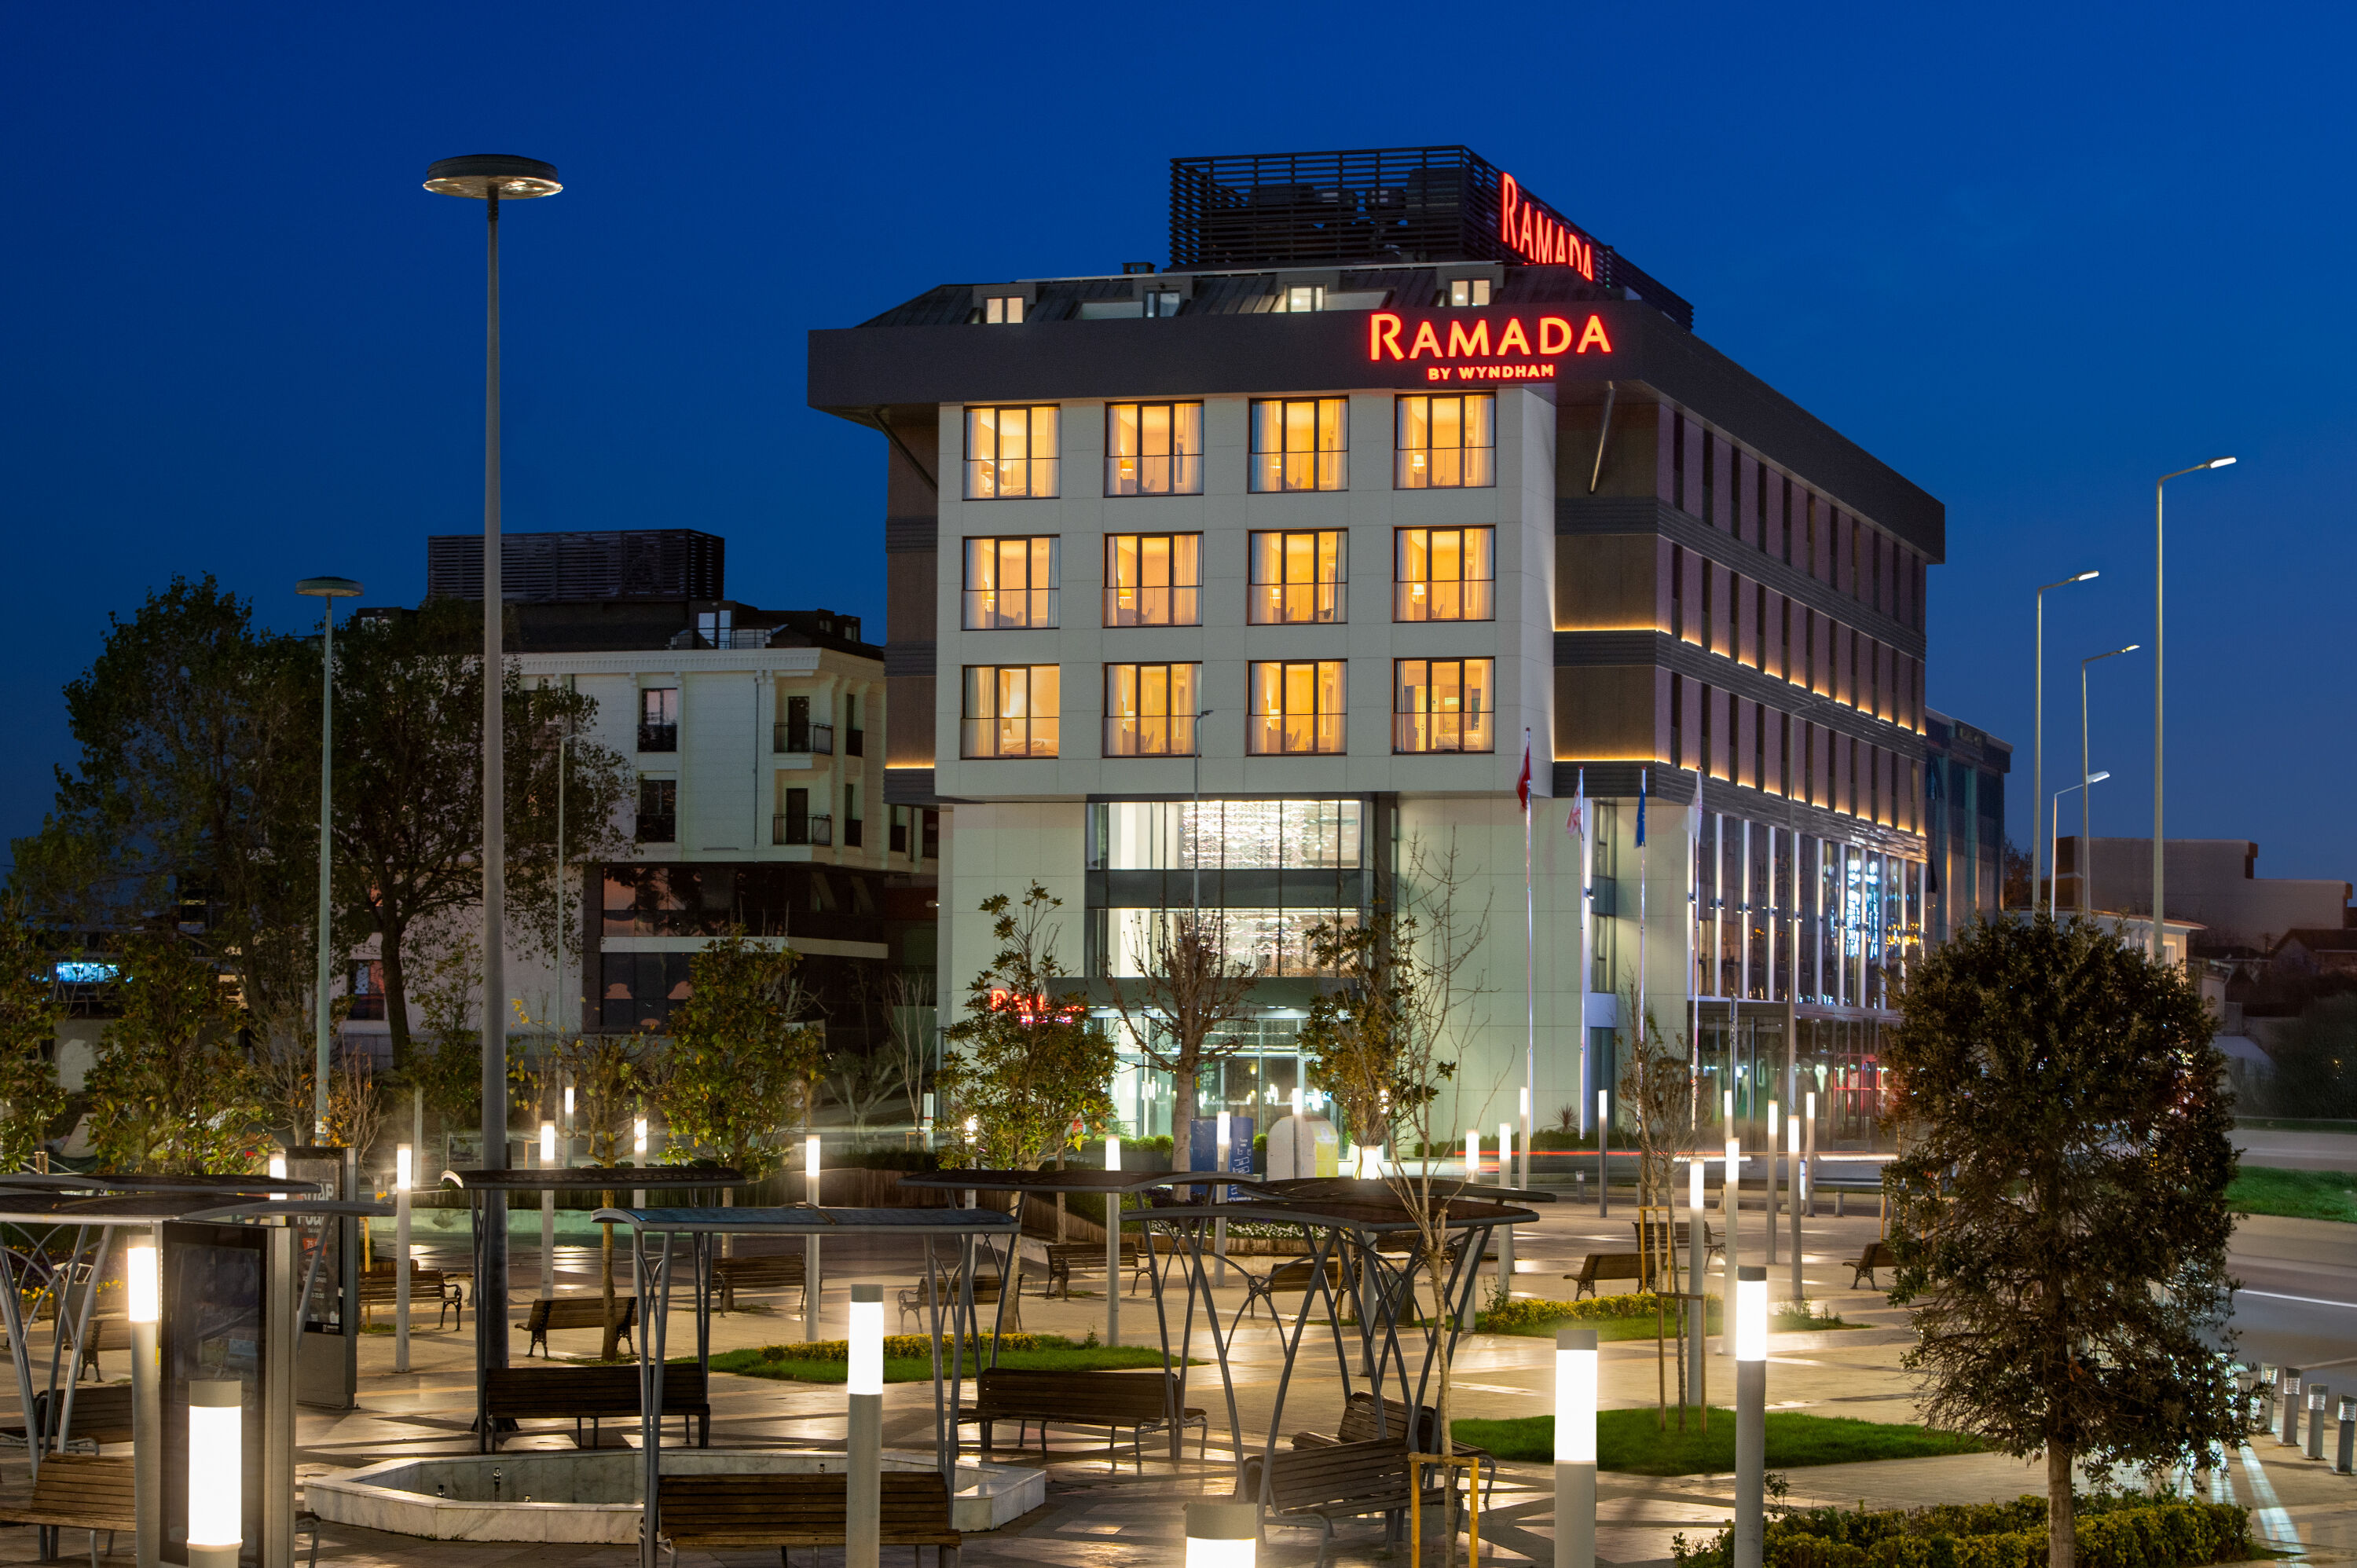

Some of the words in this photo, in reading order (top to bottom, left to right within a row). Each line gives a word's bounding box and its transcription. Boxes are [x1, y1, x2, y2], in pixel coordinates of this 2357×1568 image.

[1502, 172, 1593, 281] RAMADA
[1369, 313, 1612, 361] RAMADA
[1427, 367, 1452, 381] BY
[1457, 364, 1555, 380] WYNDHAM
